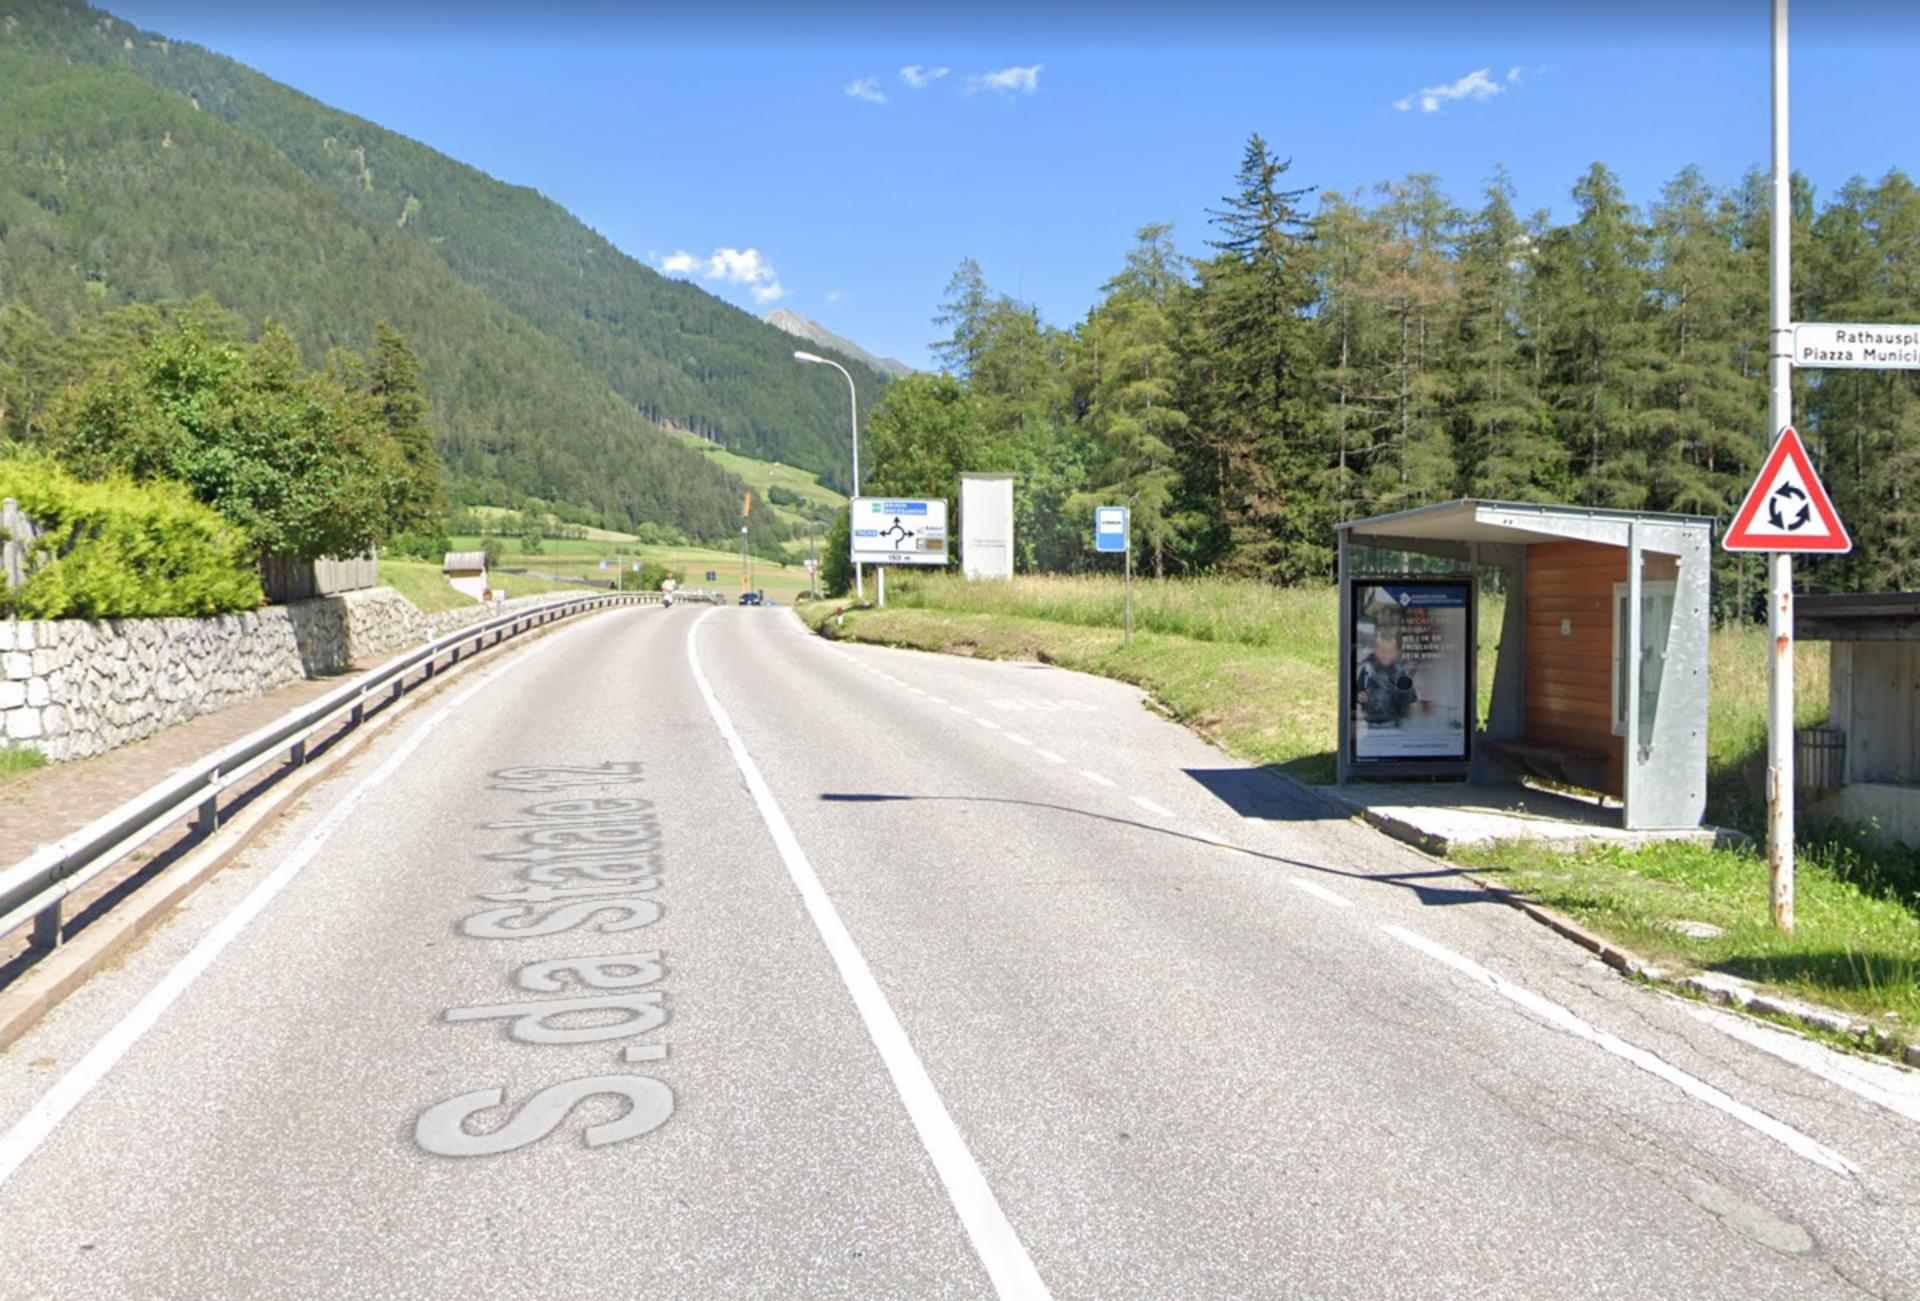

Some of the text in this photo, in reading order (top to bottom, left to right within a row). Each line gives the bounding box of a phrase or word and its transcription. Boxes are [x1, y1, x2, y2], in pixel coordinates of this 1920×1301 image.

[1836, 330, 1919, 346] Rathauspl
[1803, 347, 1920, 363] Piazza Munici
